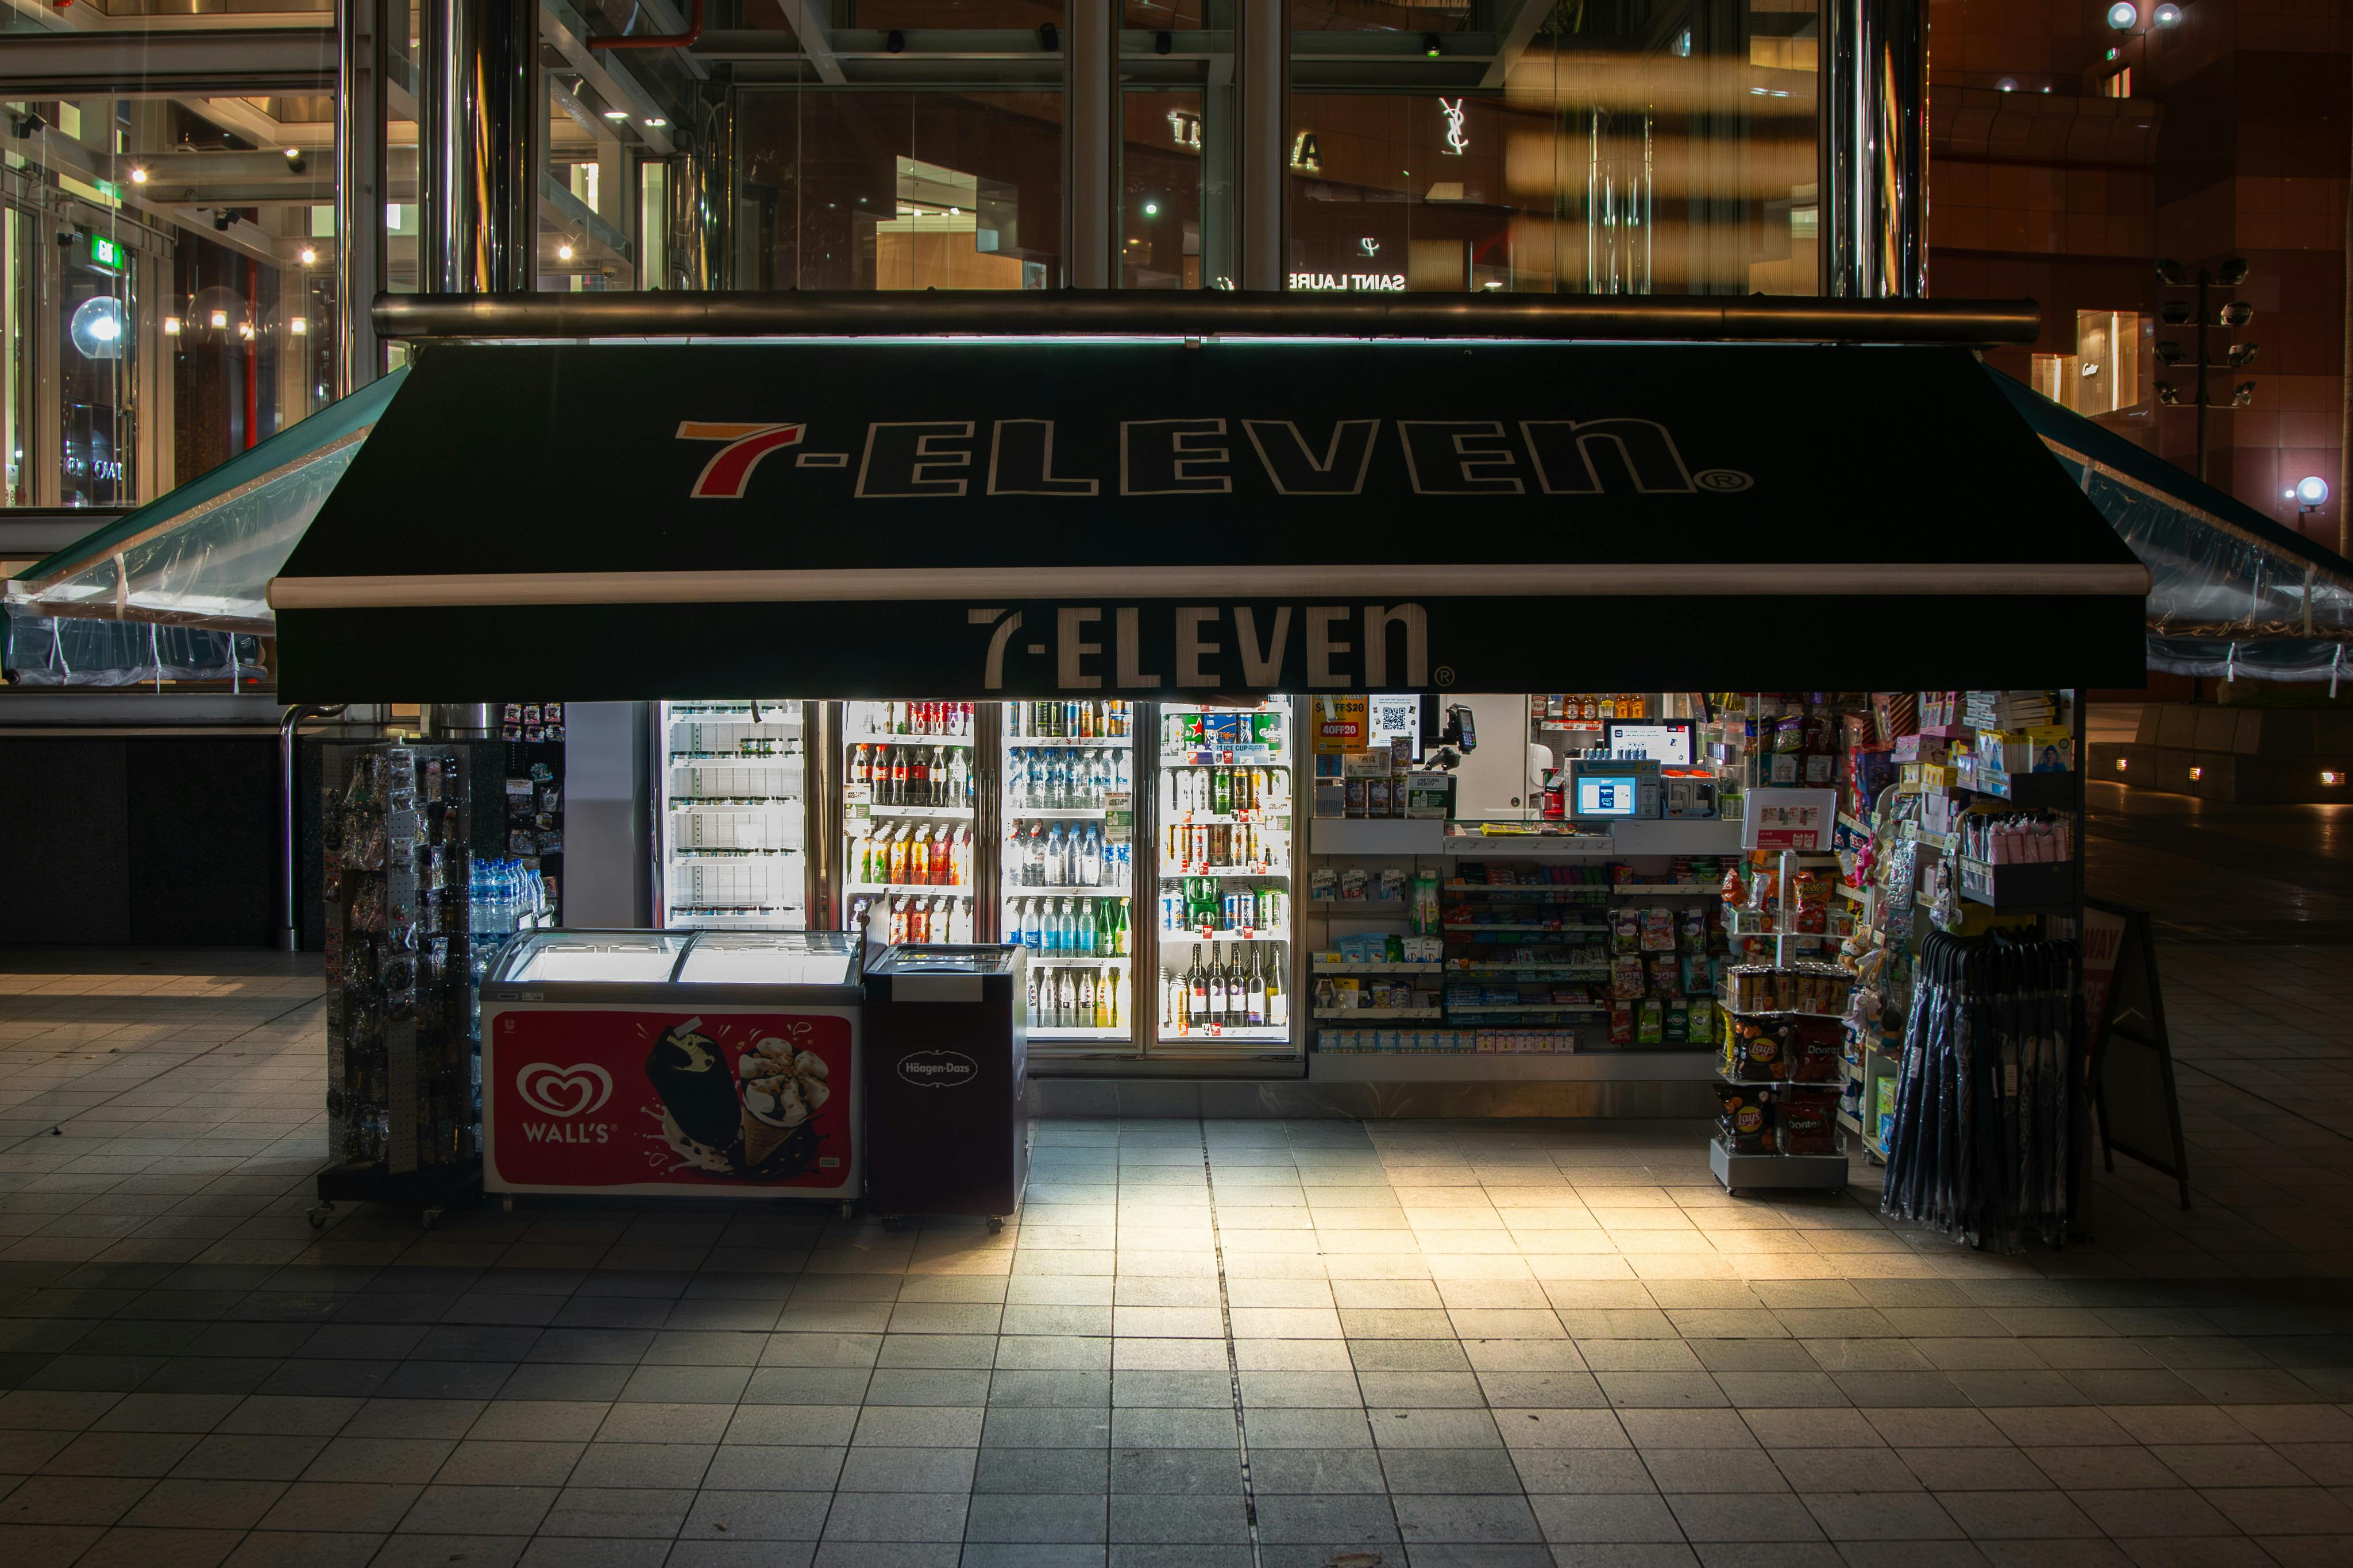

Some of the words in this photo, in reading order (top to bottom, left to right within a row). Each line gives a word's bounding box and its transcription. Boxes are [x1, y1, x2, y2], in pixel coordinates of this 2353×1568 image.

[1347, 702, 1364, 712] $20
[1218, 731, 1236, 740] Tiger
[1750, 1043, 1776, 1058] Lay's
[1737, 1111, 1761, 1127] Lay's
[522, 1122, 609, 1144] WALL'S
